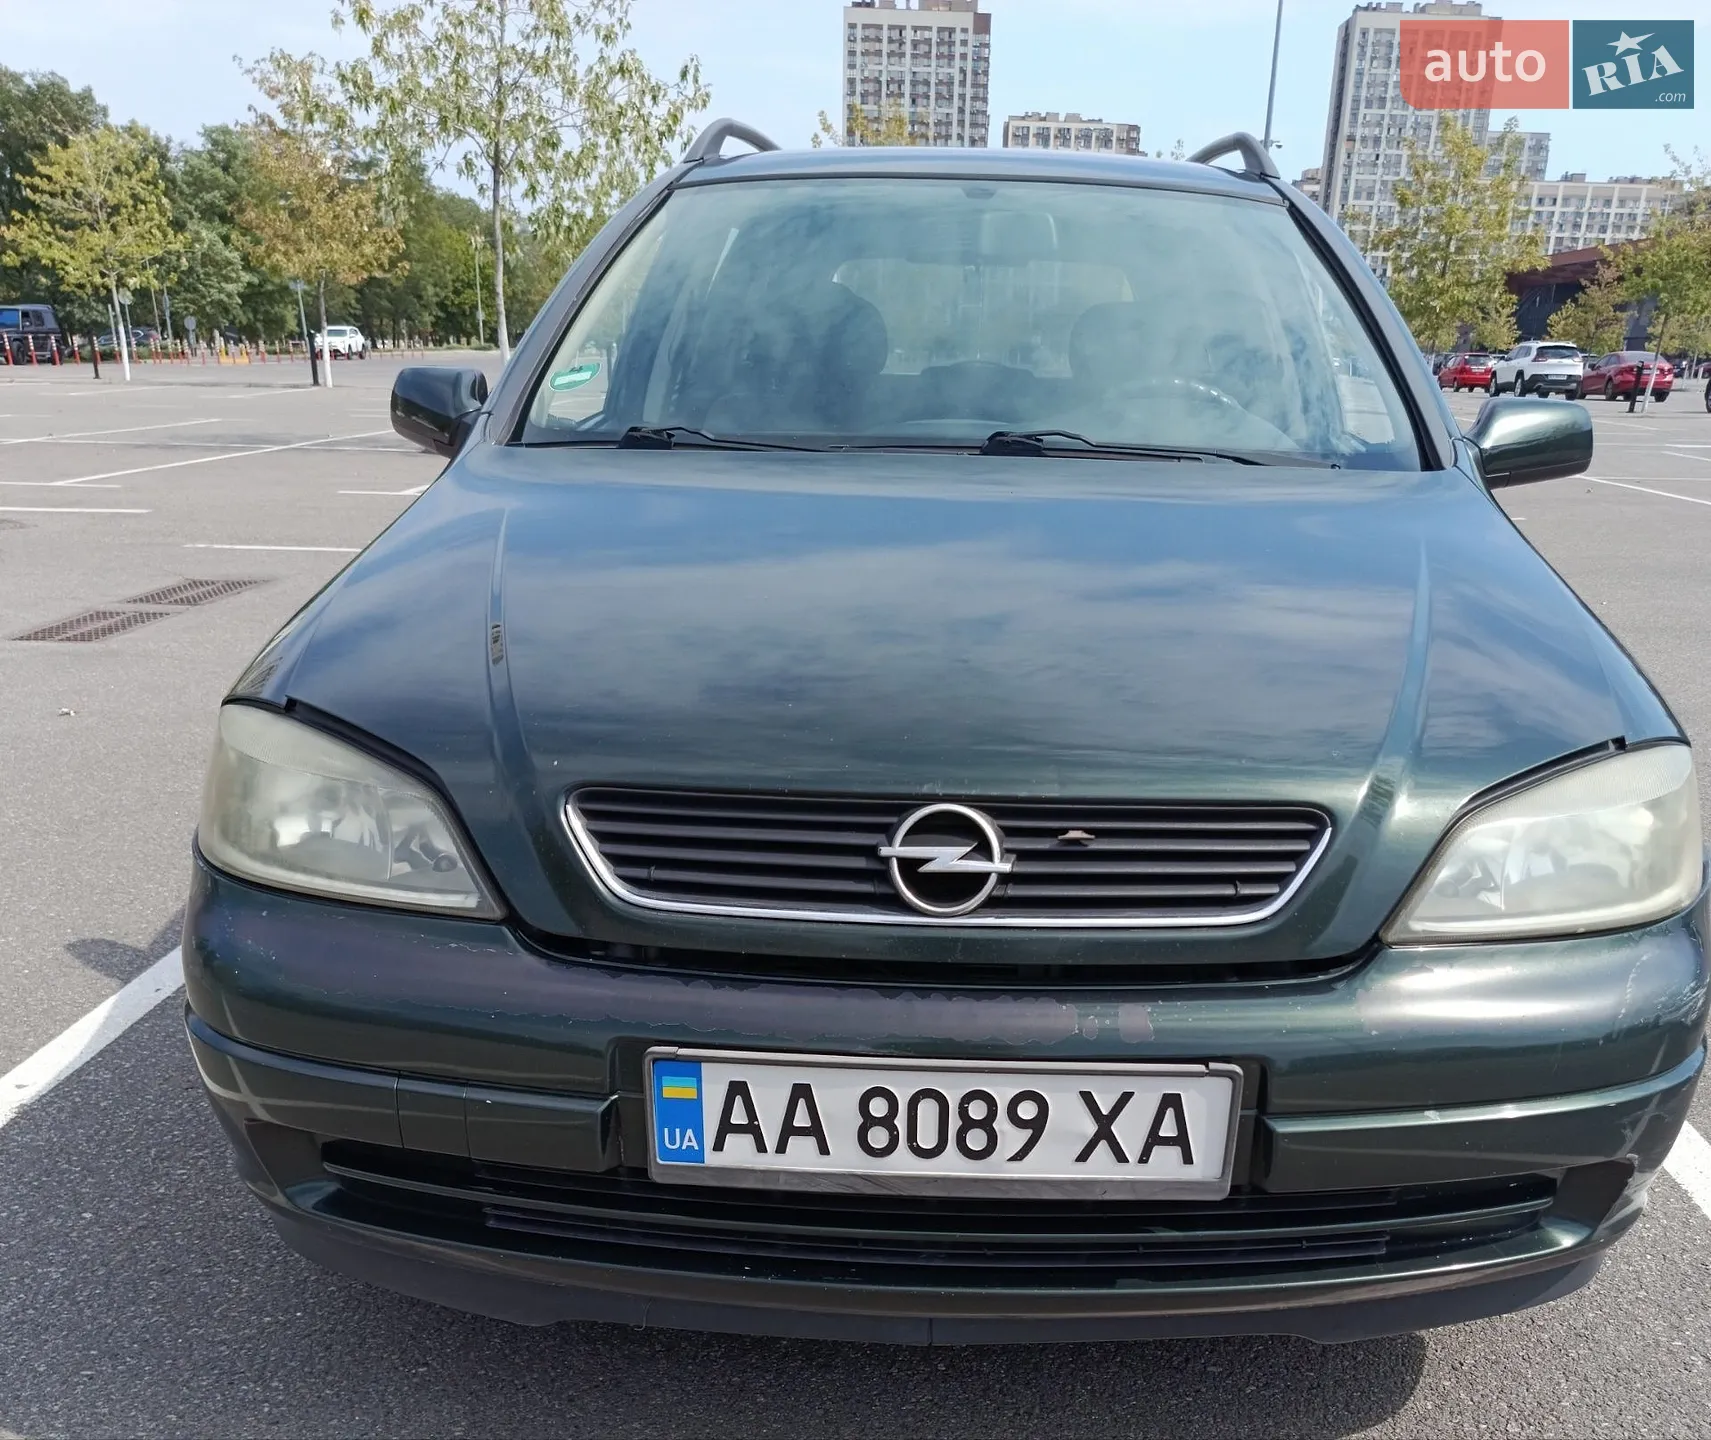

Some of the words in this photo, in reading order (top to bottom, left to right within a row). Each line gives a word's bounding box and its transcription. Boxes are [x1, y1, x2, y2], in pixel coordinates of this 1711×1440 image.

[664, 1127, 699, 1151] UA
[711, 1079, 831, 1157] AA
[857, 1085, 1050, 1162] 8089
[1074, 1090, 1194, 1166] XA
